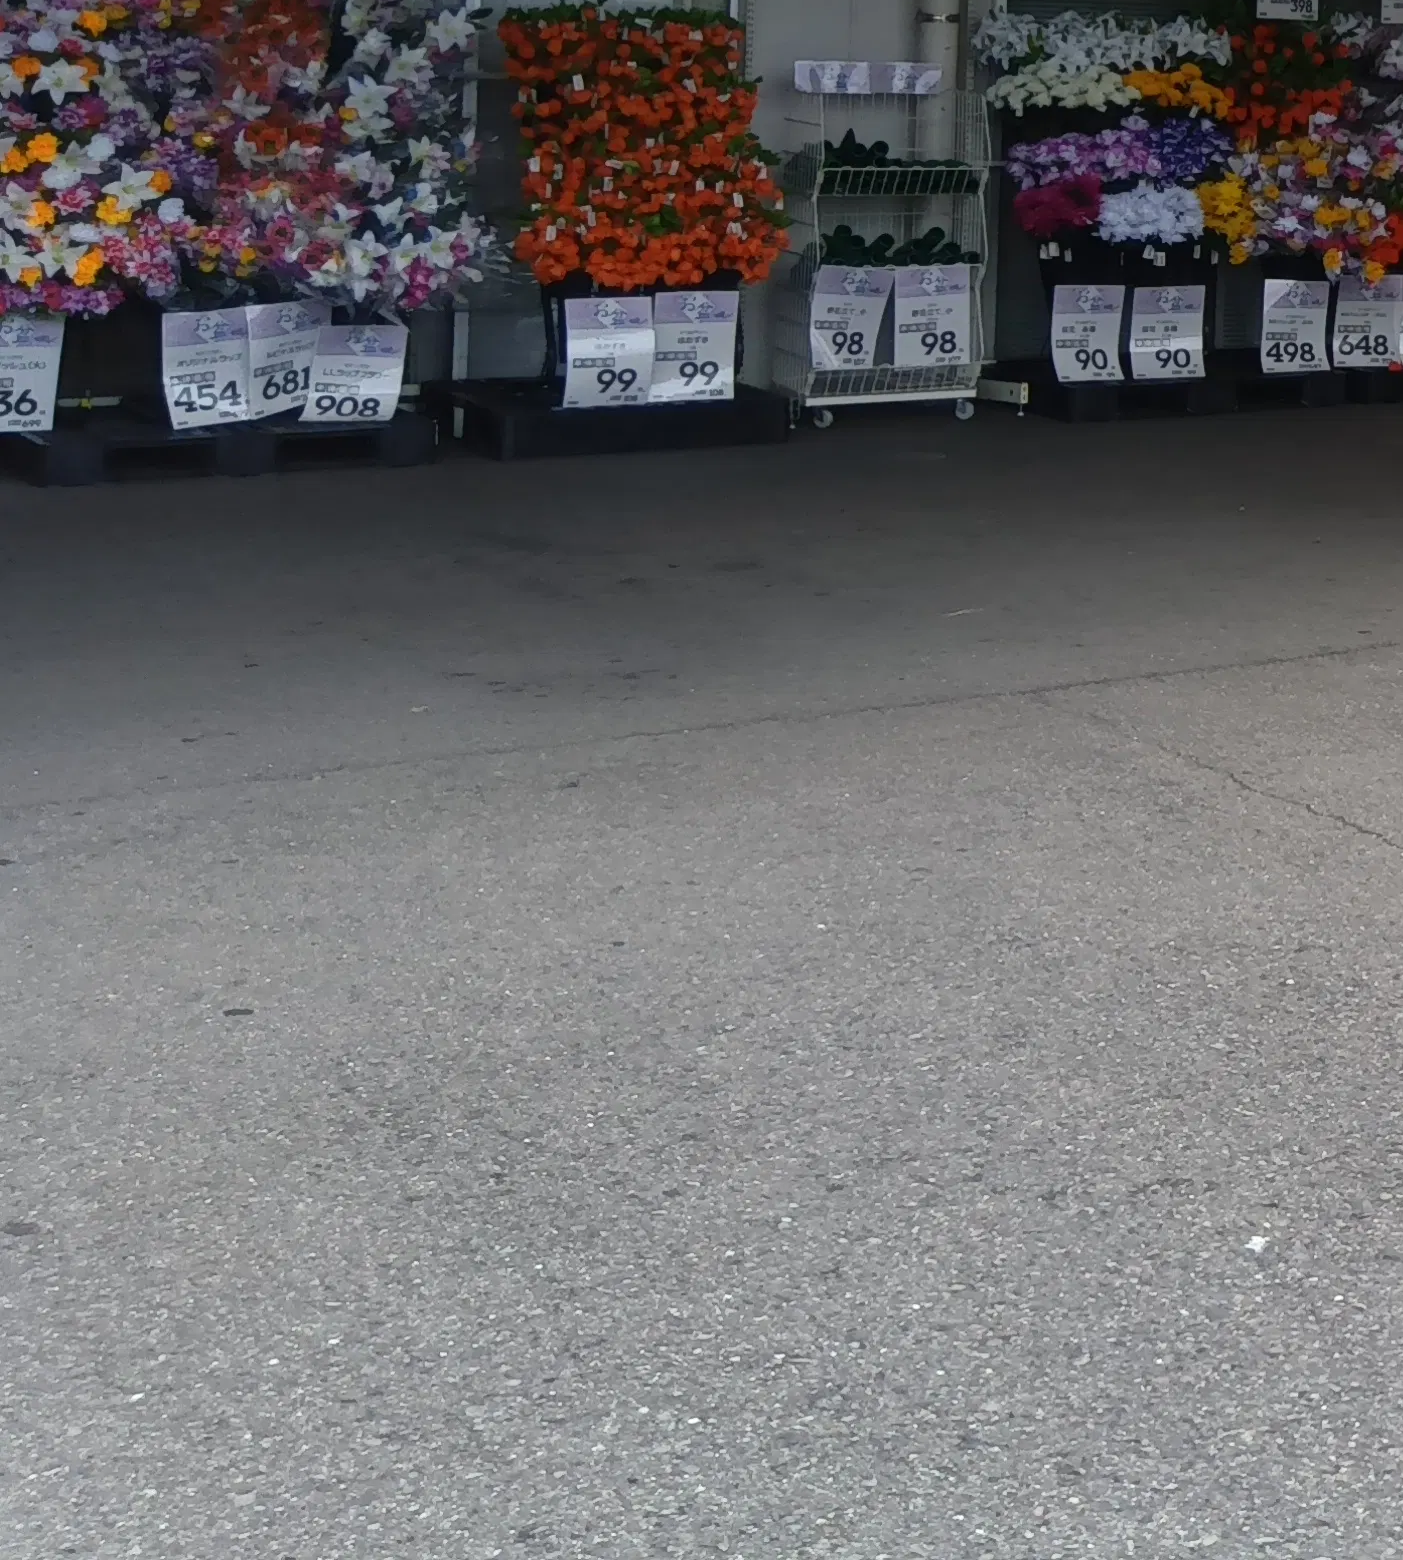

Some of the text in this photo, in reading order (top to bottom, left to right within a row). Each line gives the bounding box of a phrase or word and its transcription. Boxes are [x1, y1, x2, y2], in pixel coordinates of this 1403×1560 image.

[1290, 0, 1312, 13] 398
[832, 331, 864, 355] 98
[921, 330, 957, 355] 98
[1266, 342, 1315, 362] 498
[1338, 334, 1389, 356] 648
[1075, 348, 1108, 370] 90
[1155, 348, 1190, 368] 90
[263, 366, 311, 400] 681
[597, 368, 637, 393] 99
[679, 360, 719, 386] 99
[174, 380, 242, 413] 454
[315, 395, 380, 417] 908
